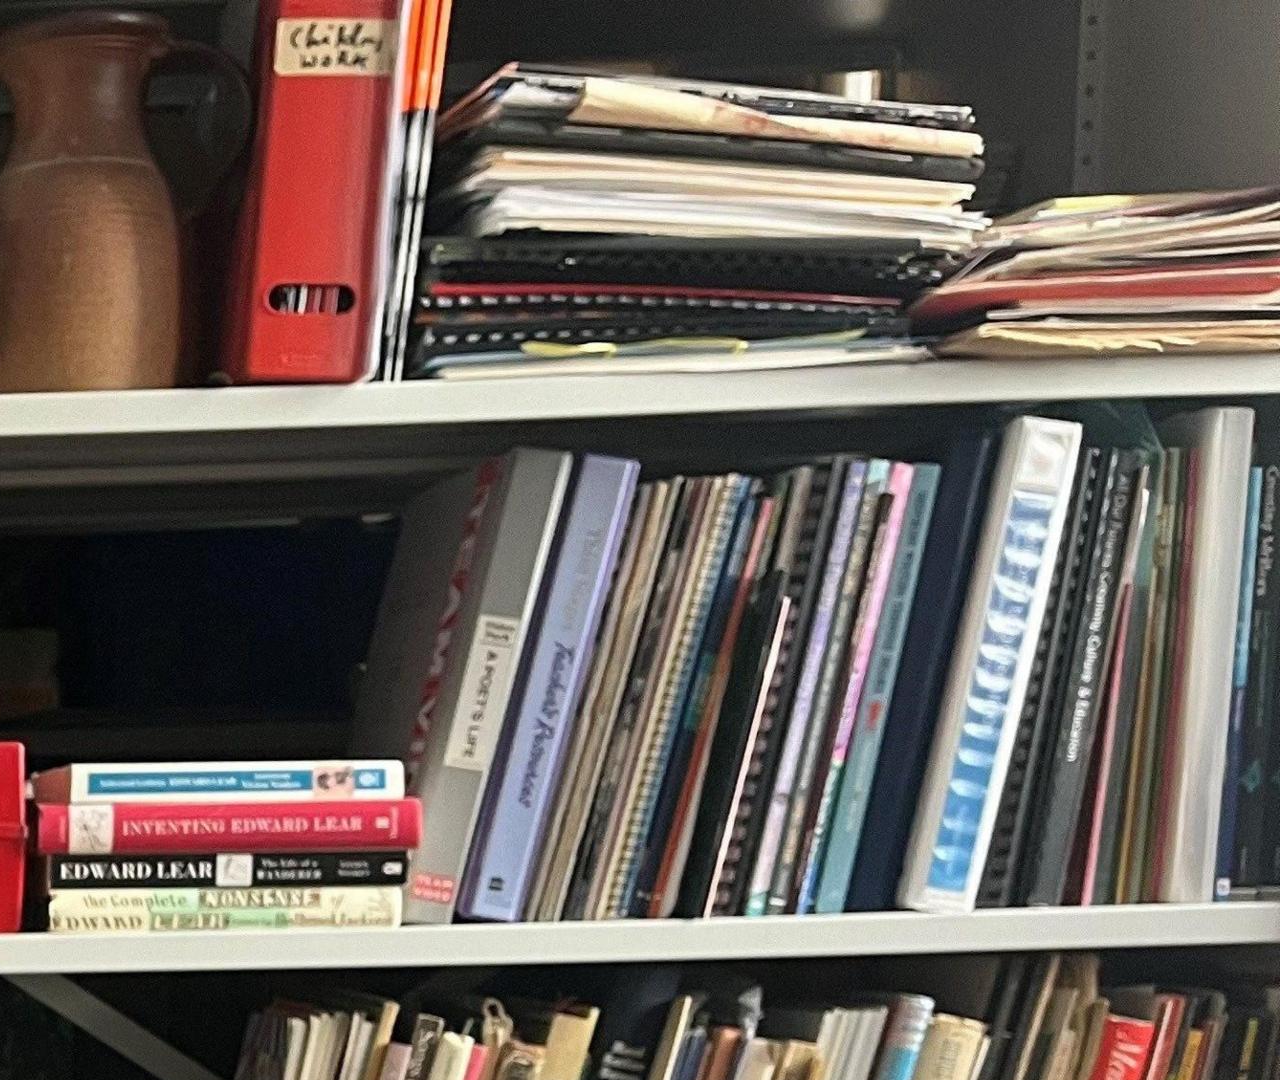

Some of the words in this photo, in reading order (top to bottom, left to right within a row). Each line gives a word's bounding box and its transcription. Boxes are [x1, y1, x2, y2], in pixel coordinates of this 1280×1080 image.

[122, 818, 226, 837] INVENTING
[230, 816, 310, 835] EDWARD
[313, 816, 364, 832] LEAR
[59, 861, 153, 881] EDWARD
[156, 860, 213, 880] LEAR
